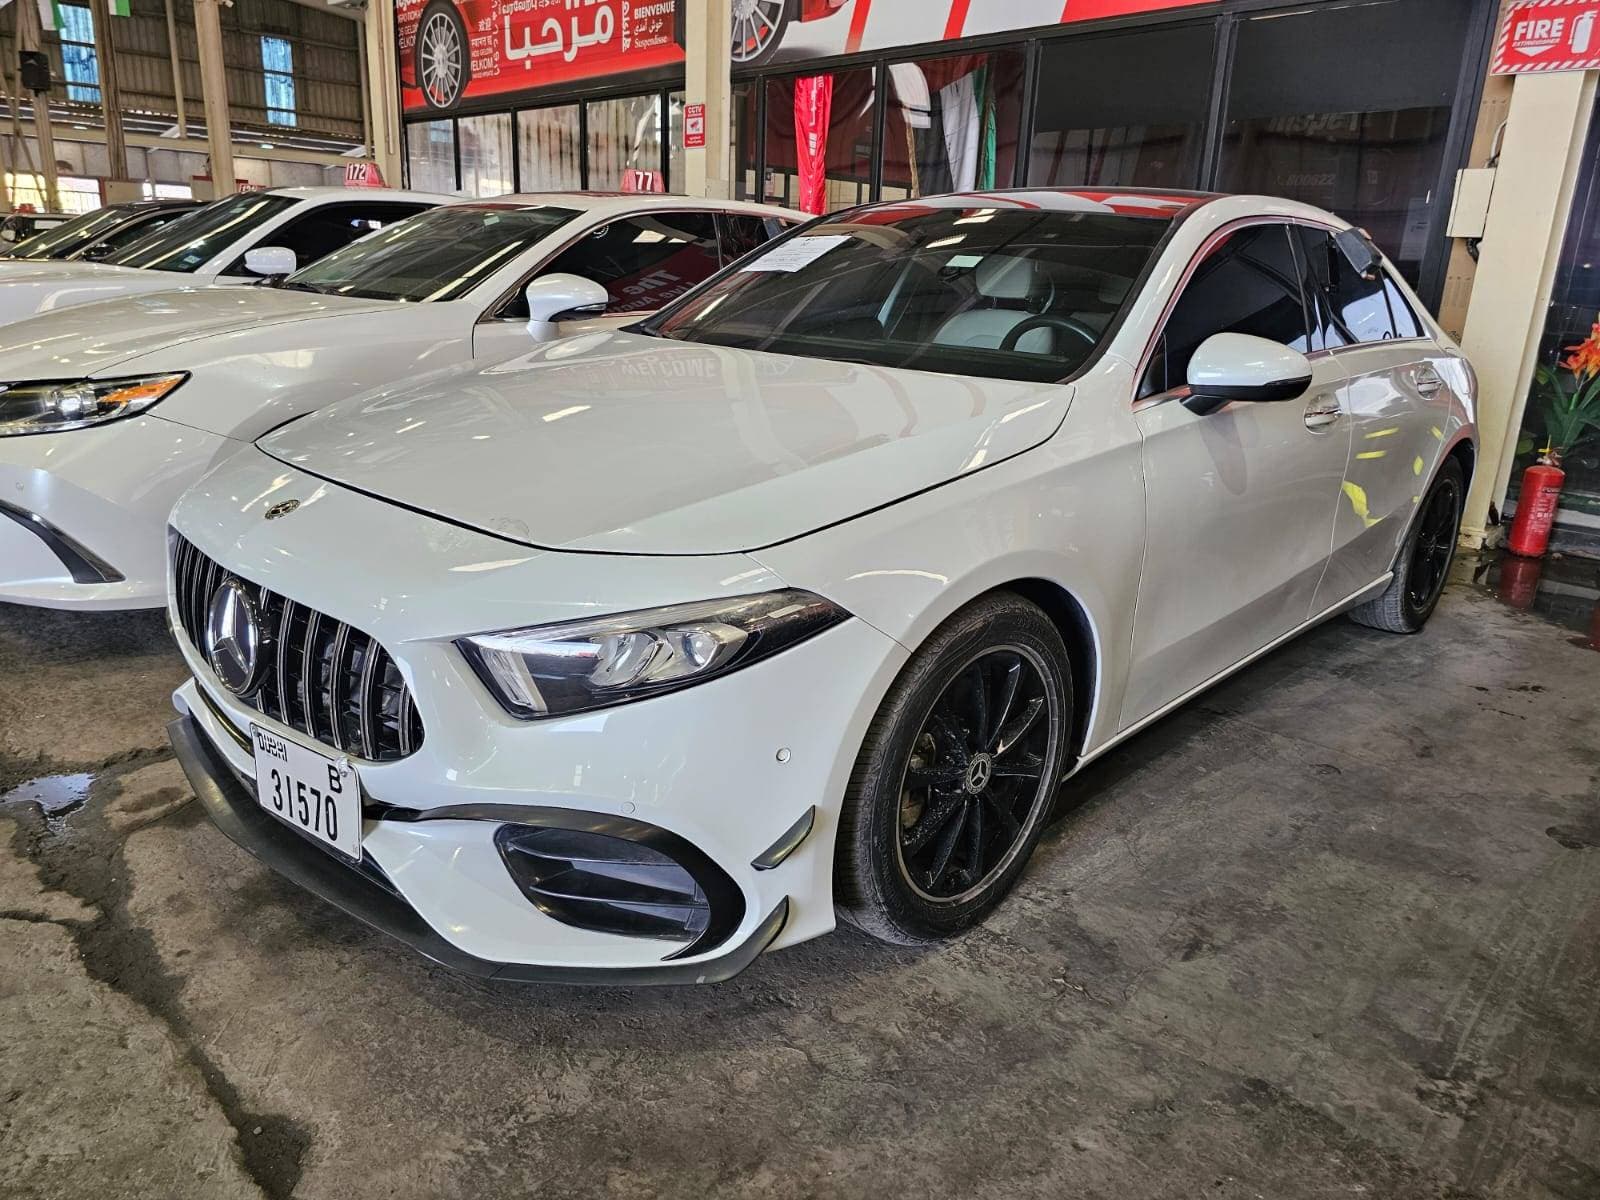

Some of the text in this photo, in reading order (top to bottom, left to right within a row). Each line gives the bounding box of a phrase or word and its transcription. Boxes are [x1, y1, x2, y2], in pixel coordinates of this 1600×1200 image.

[634, 1, 675, 19] BIENVENUE
[504, 5, 614, 70] مرحبا
[1513, 17, 1565, 41] FIRE
[349, 163, 366, 180] 172
[635, 171, 653, 190] 77
[327, 764, 343, 794] B
[271, 768, 338, 841] 31570
